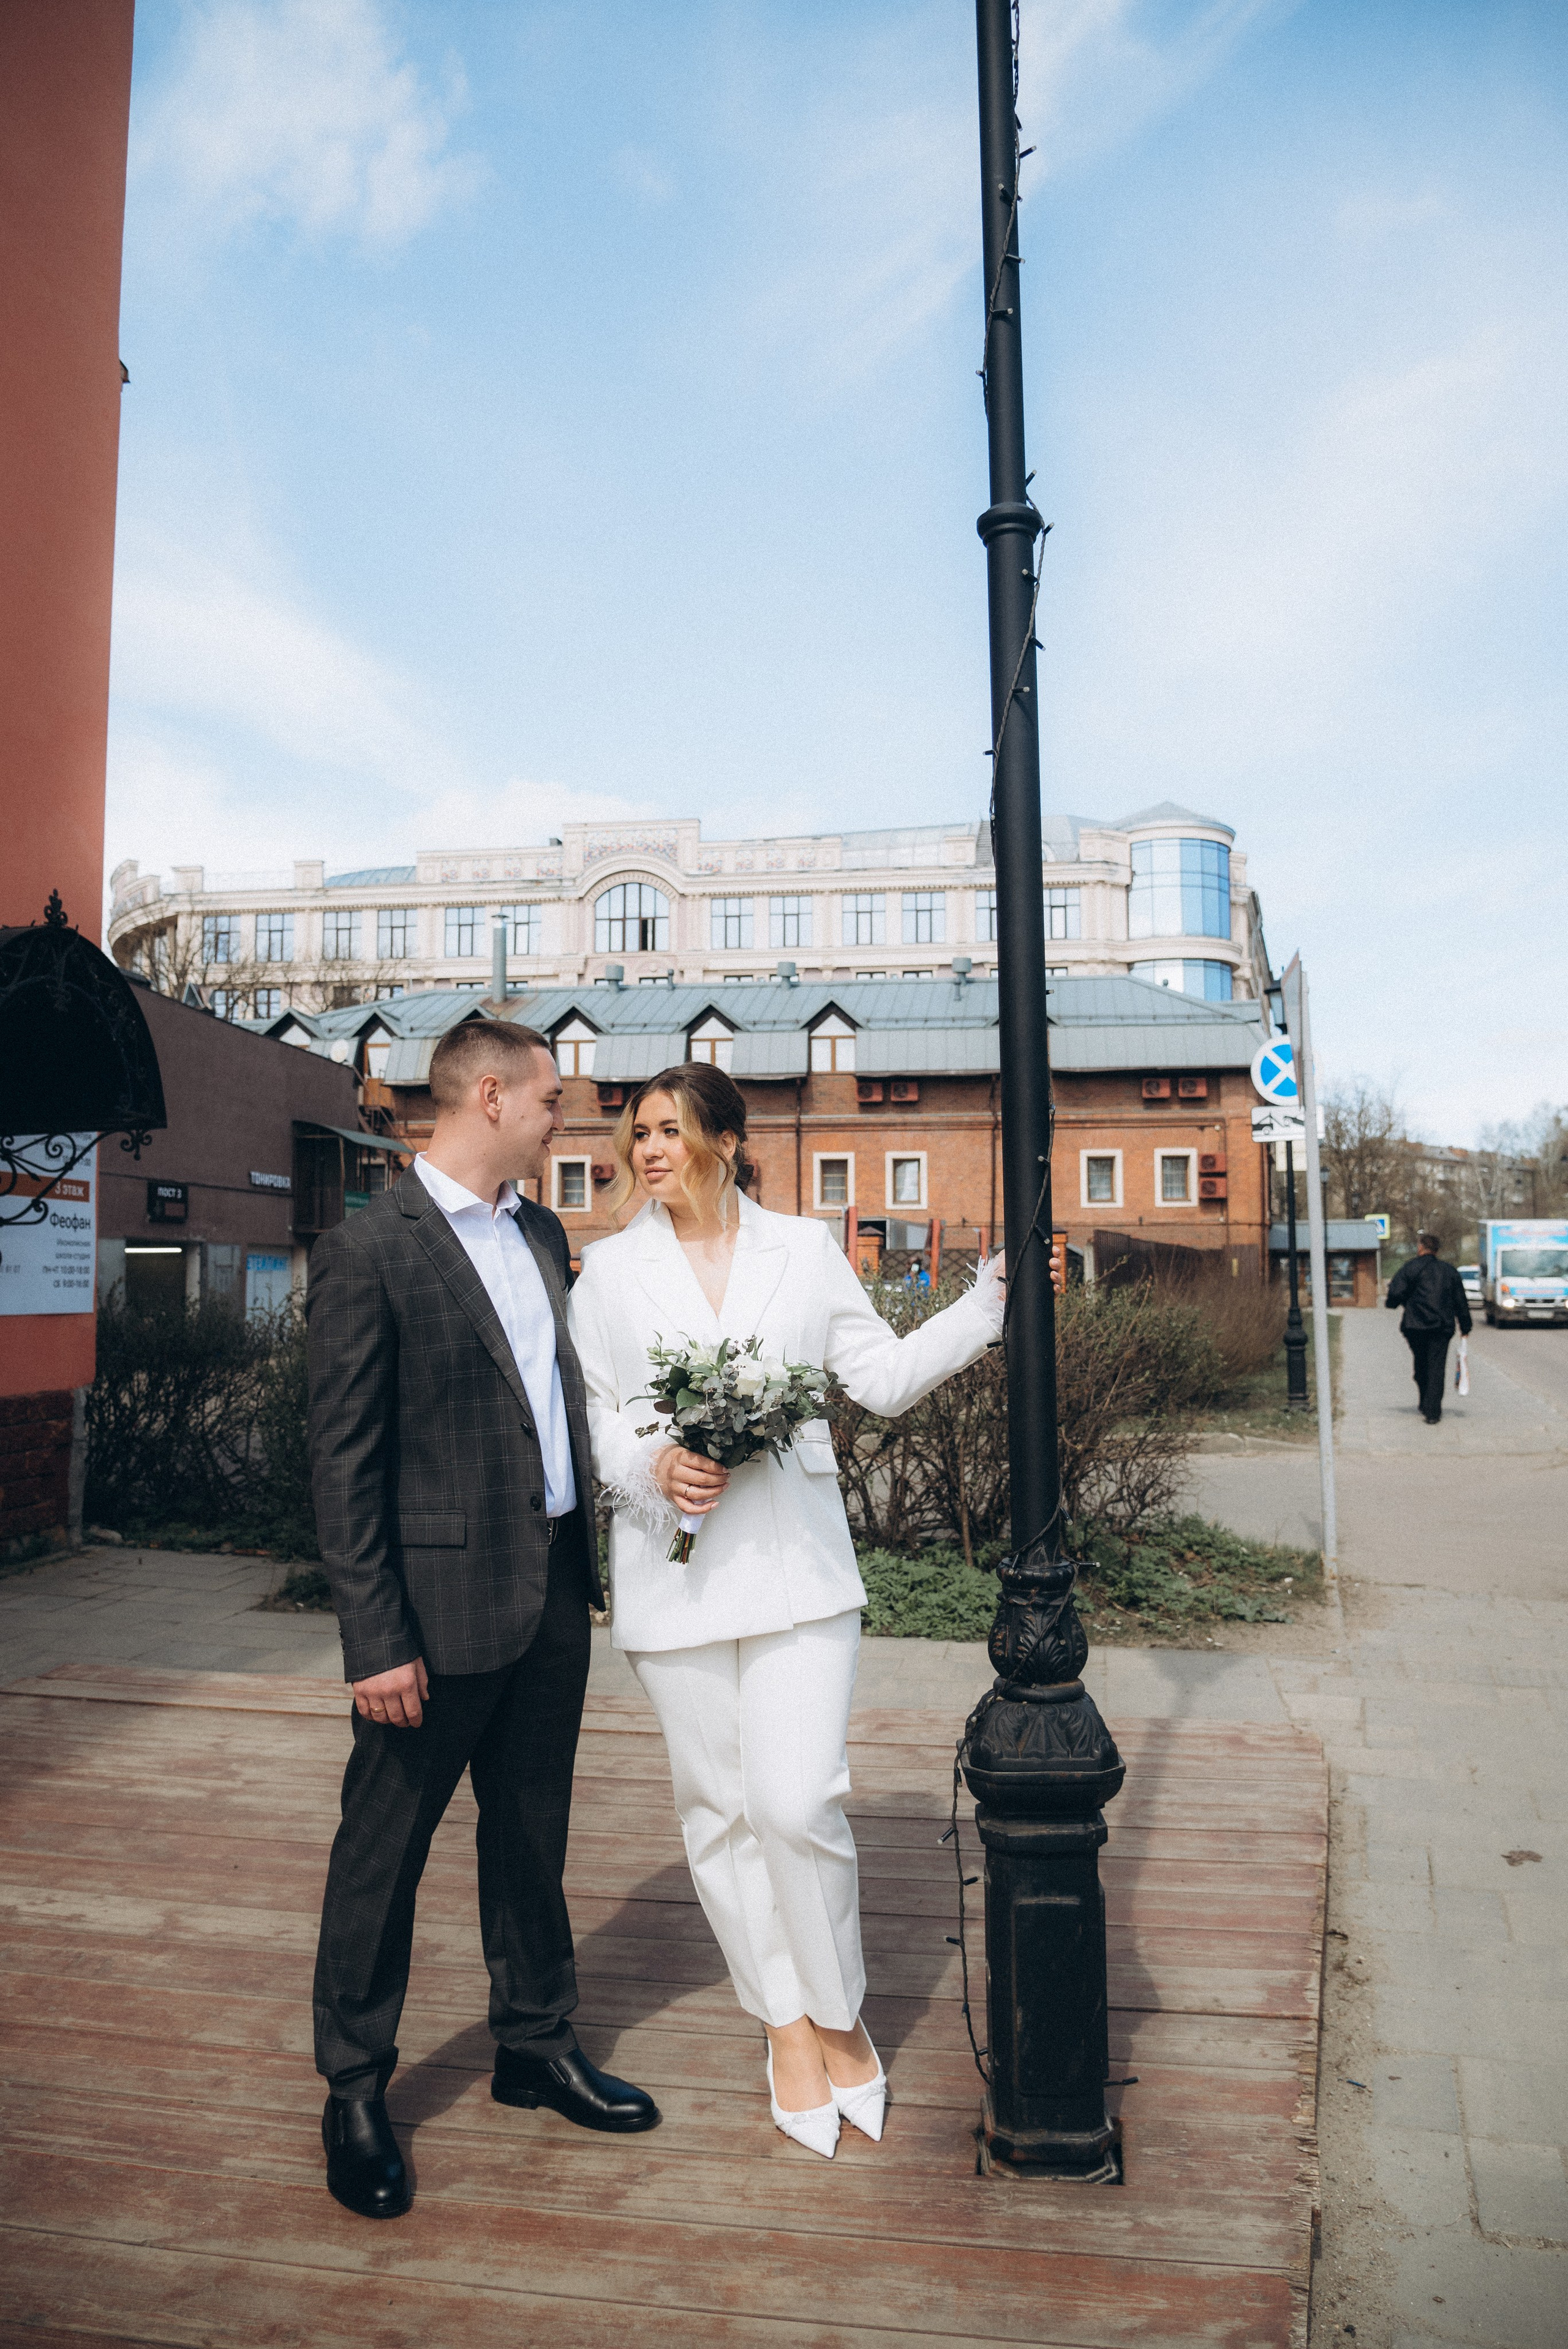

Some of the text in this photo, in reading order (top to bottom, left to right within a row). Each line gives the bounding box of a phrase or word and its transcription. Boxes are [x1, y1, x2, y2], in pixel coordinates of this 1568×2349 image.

[251, 1171, 292, 1190] ТОНИРОВКА
[62, 1184, 85, 1197] этаж
[177, 1188, 183, 1199] 3
[50, 1212, 91, 1232] Феофан
